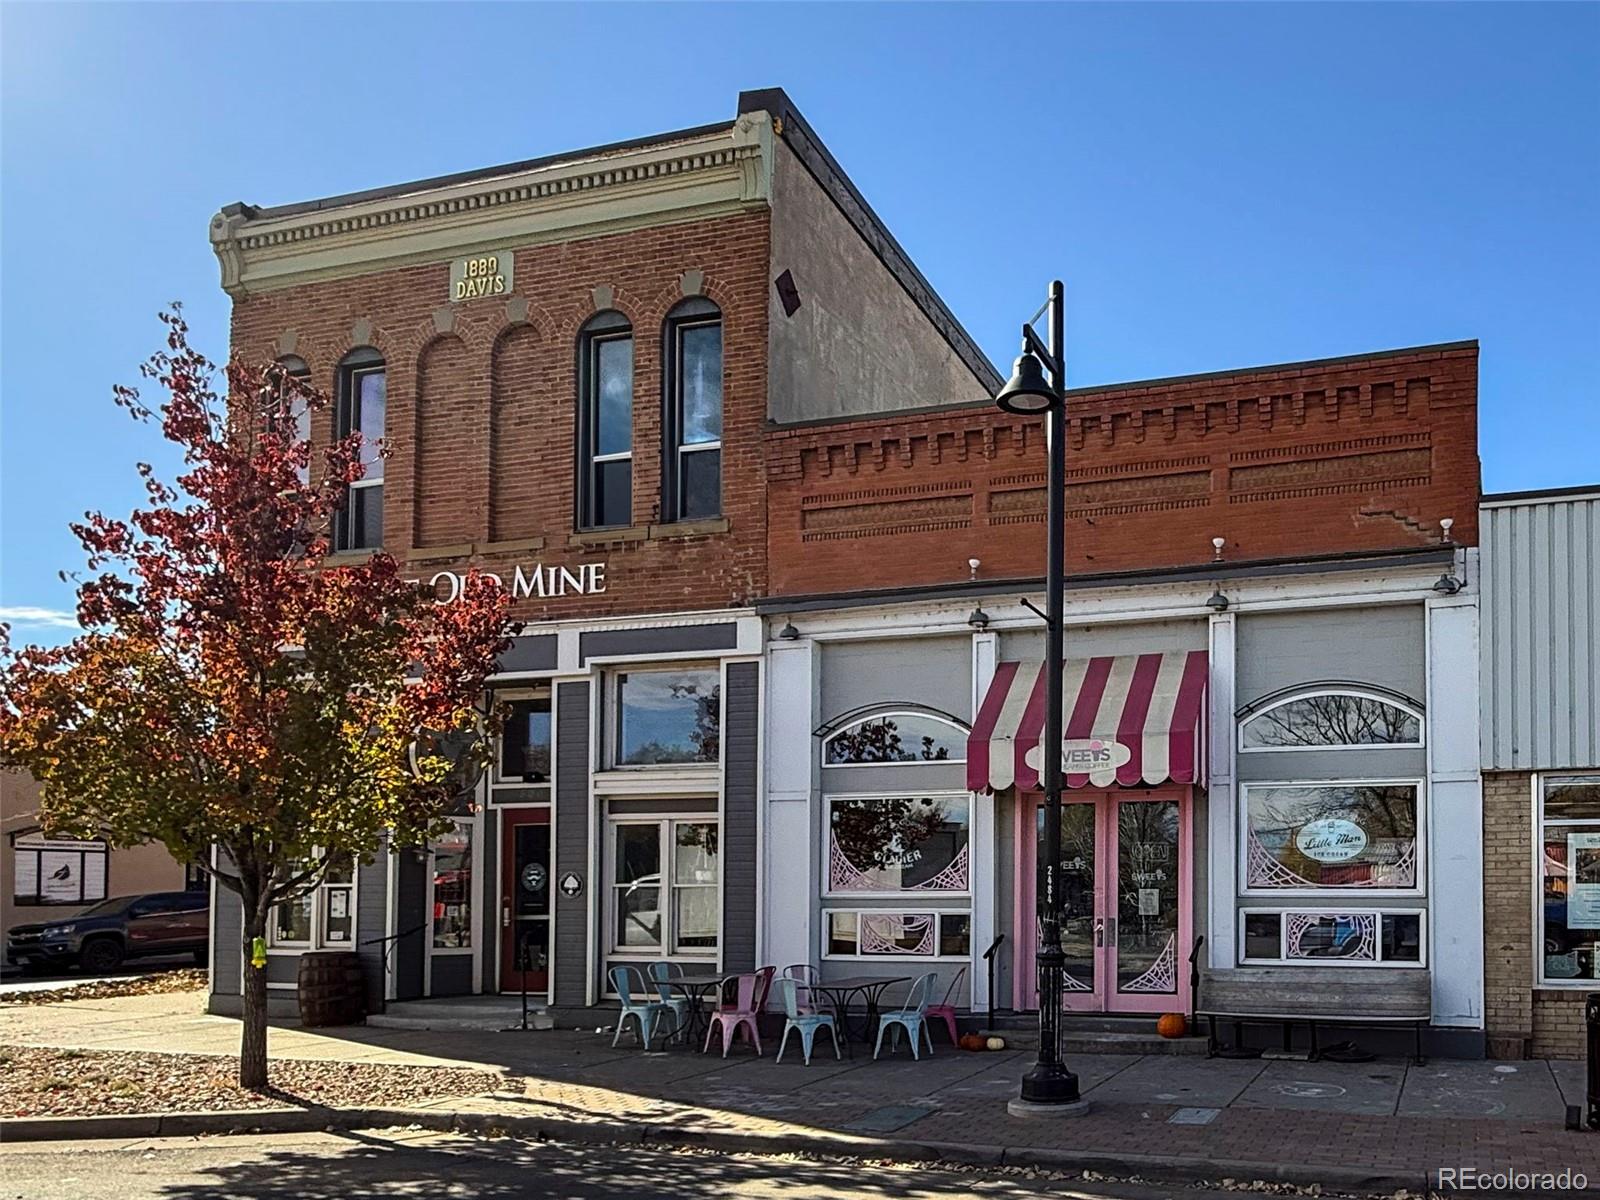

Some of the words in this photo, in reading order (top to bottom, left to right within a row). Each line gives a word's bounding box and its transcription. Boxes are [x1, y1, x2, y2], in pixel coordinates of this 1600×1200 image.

[463, 257, 498, 278] 1880
[456, 275, 505, 299] DAVIS
[512, 562, 607, 598] MINE
